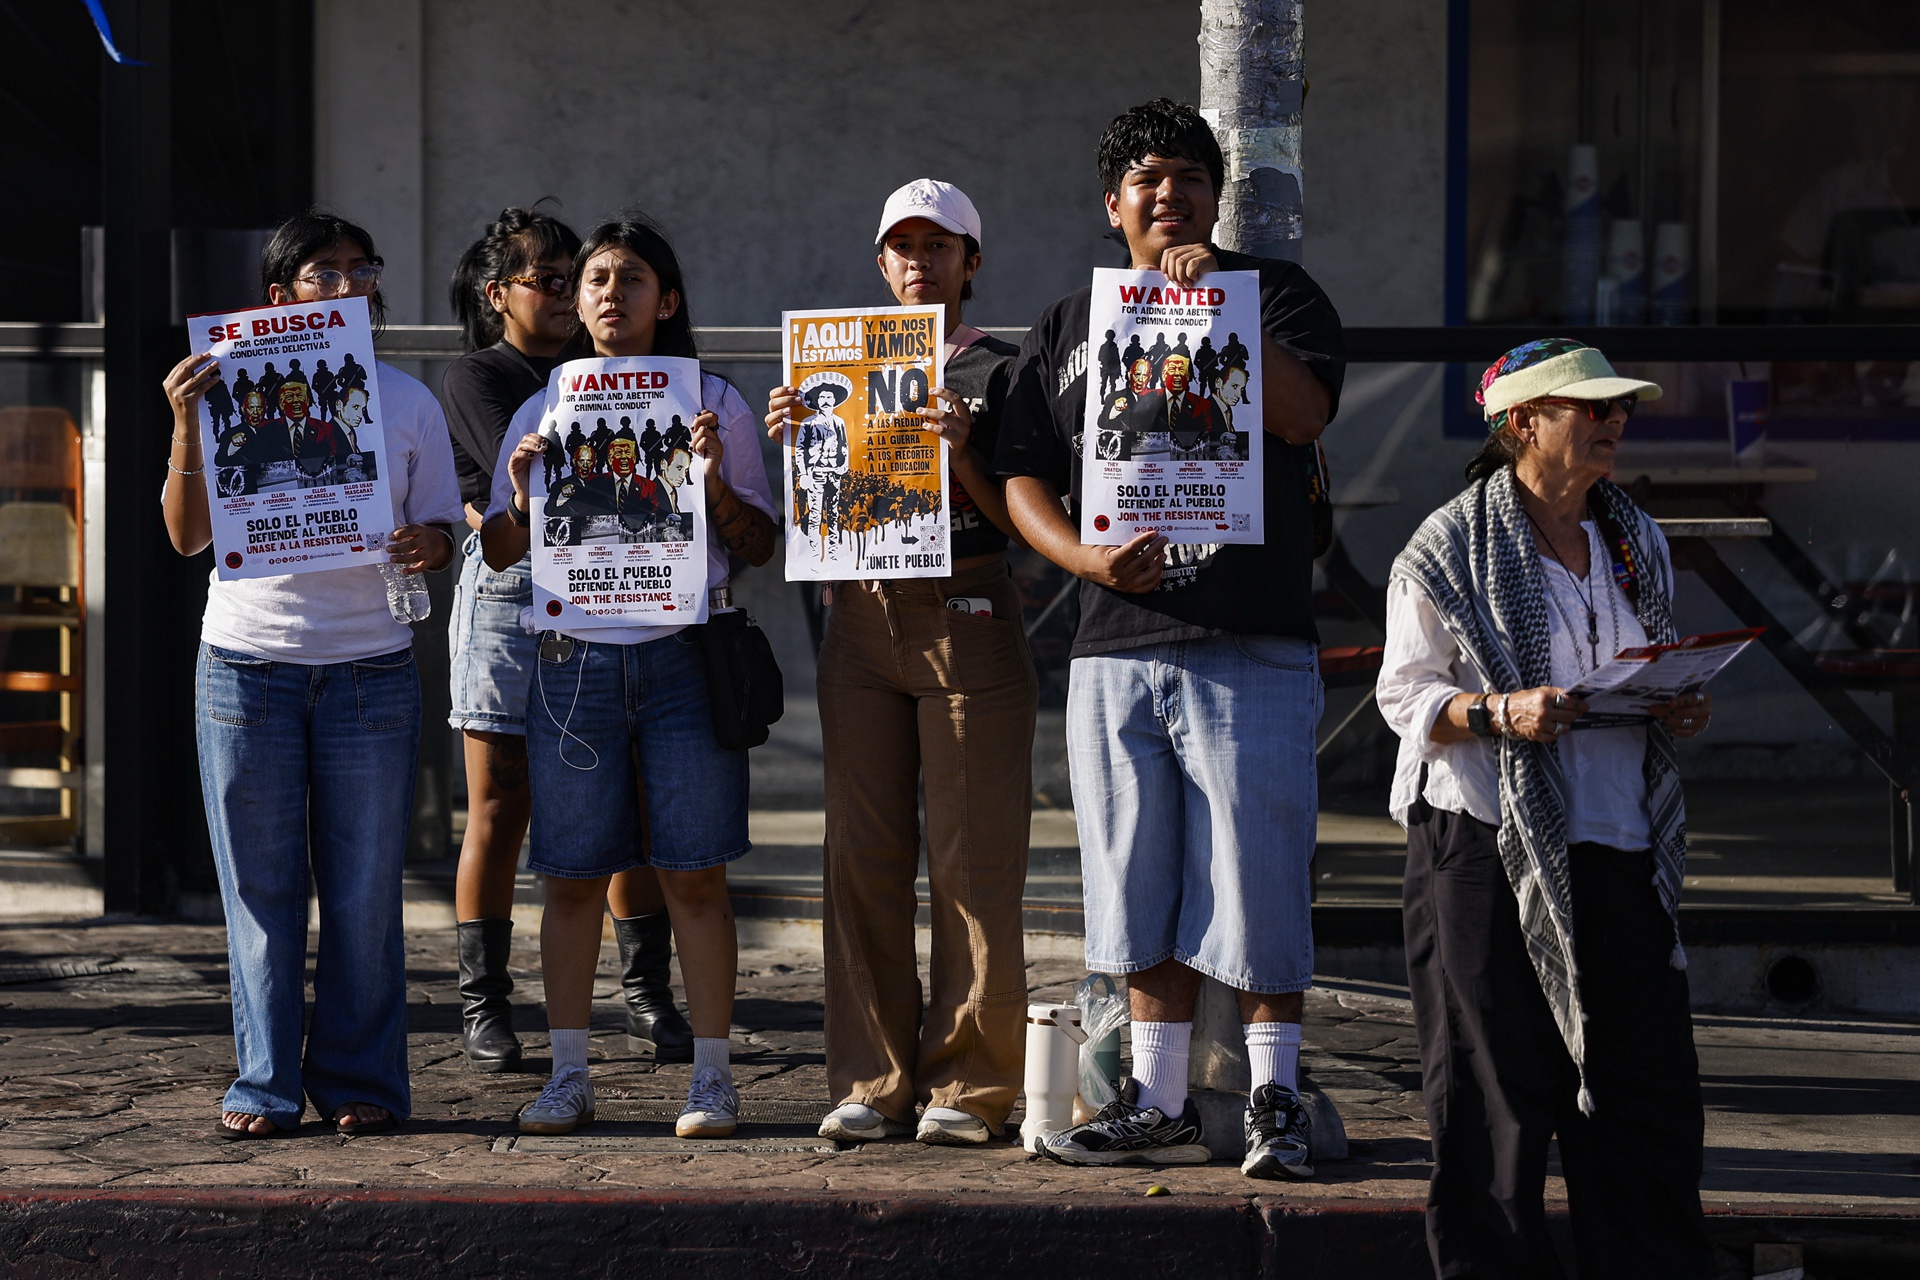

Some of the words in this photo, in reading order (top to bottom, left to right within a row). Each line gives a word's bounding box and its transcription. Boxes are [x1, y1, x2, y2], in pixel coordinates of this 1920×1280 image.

[1119, 286, 1225, 306] WANTED
[1122, 306, 1137, 314] FOR
[208, 323, 242, 343] SE
[252, 310, 346, 337] BUSCA
[865, 321, 873, 333] Y
[880, 320, 896, 332] NO
[1136, 317, 1171, 325] CRIMINAL
[234, 340, 251, 349] POR
[254, 334, 310, 346] COMPLICIDAD
[230, 346, 279, 359] CONDUCTAS
[282, 342, 330, 353] DELICTIVAS
[802, 348, 862, 363] ESTAMOS
[562, 372, 669, 392] WANTED
[579, 393, 604, 401] AIDING
[626, 391, 664, 399] ABETTING
[868, 368, 928, 414] NO
[575, 403, 612, 411] CRIMINAL
[615, 402, 651, 410] CONDUCT
[878, 419, 890, 428] LAS
[878, 436, 886, 445] LA
[890, 435, 920, 444] GUERRA
[878, 451, 891, 460] LOS
[895, 450, 934, 460] RECORTES
[870, 464, 874, 472] A
[878, 463, 886, 472] LA
[1117, 485, 1150, 497] SOLO
[1155, 485, 1169, 497] EL
[1175, 484, 1225, 496] PUEBLO
[1118, 499, 1165, 508] DEFIENDE
[1169, 499, 1182, 507] AL
[1186, 498, 1225, 507] PUEBLO
[246, 517, 281, 532] SOLO
[286, 515, 301, 527] EL
[306, 508, 358, 525] PUEBLO
[1118, 512, 1139, 521] JOIN
[1143, 512, 1161, 521] THE
[1165, 511, 1225, 520] RESISTANCE
[248, 530, 298, 543] DEFIENDE
[302, 528, 315, 537] AL
[319, 522, 358, 535] PUEBLO
[280, 543, 286, 551] A
[290, 541, 300, 549] LA
[304, 533, 363, 548] RESISTENCIA
[866, 554, 899, 570] ¡ÚNETE
[905, 553, 945, 568] PUEBLO!
[568, 568, 600, 580] SOLO
[605, 568, 618, 579] EL
[624, 566, 671, 579] PUEBLO
[569, 581, 614, 592] DEFIENDE
[619, 581, 631, 590] AL
[635, 580, 671, 589] PUEBLO
[569, 596, 590, 604] JOIN
[593, 595, 612, 603] THE
[615, 592, 671, 603] RESISTANCE
